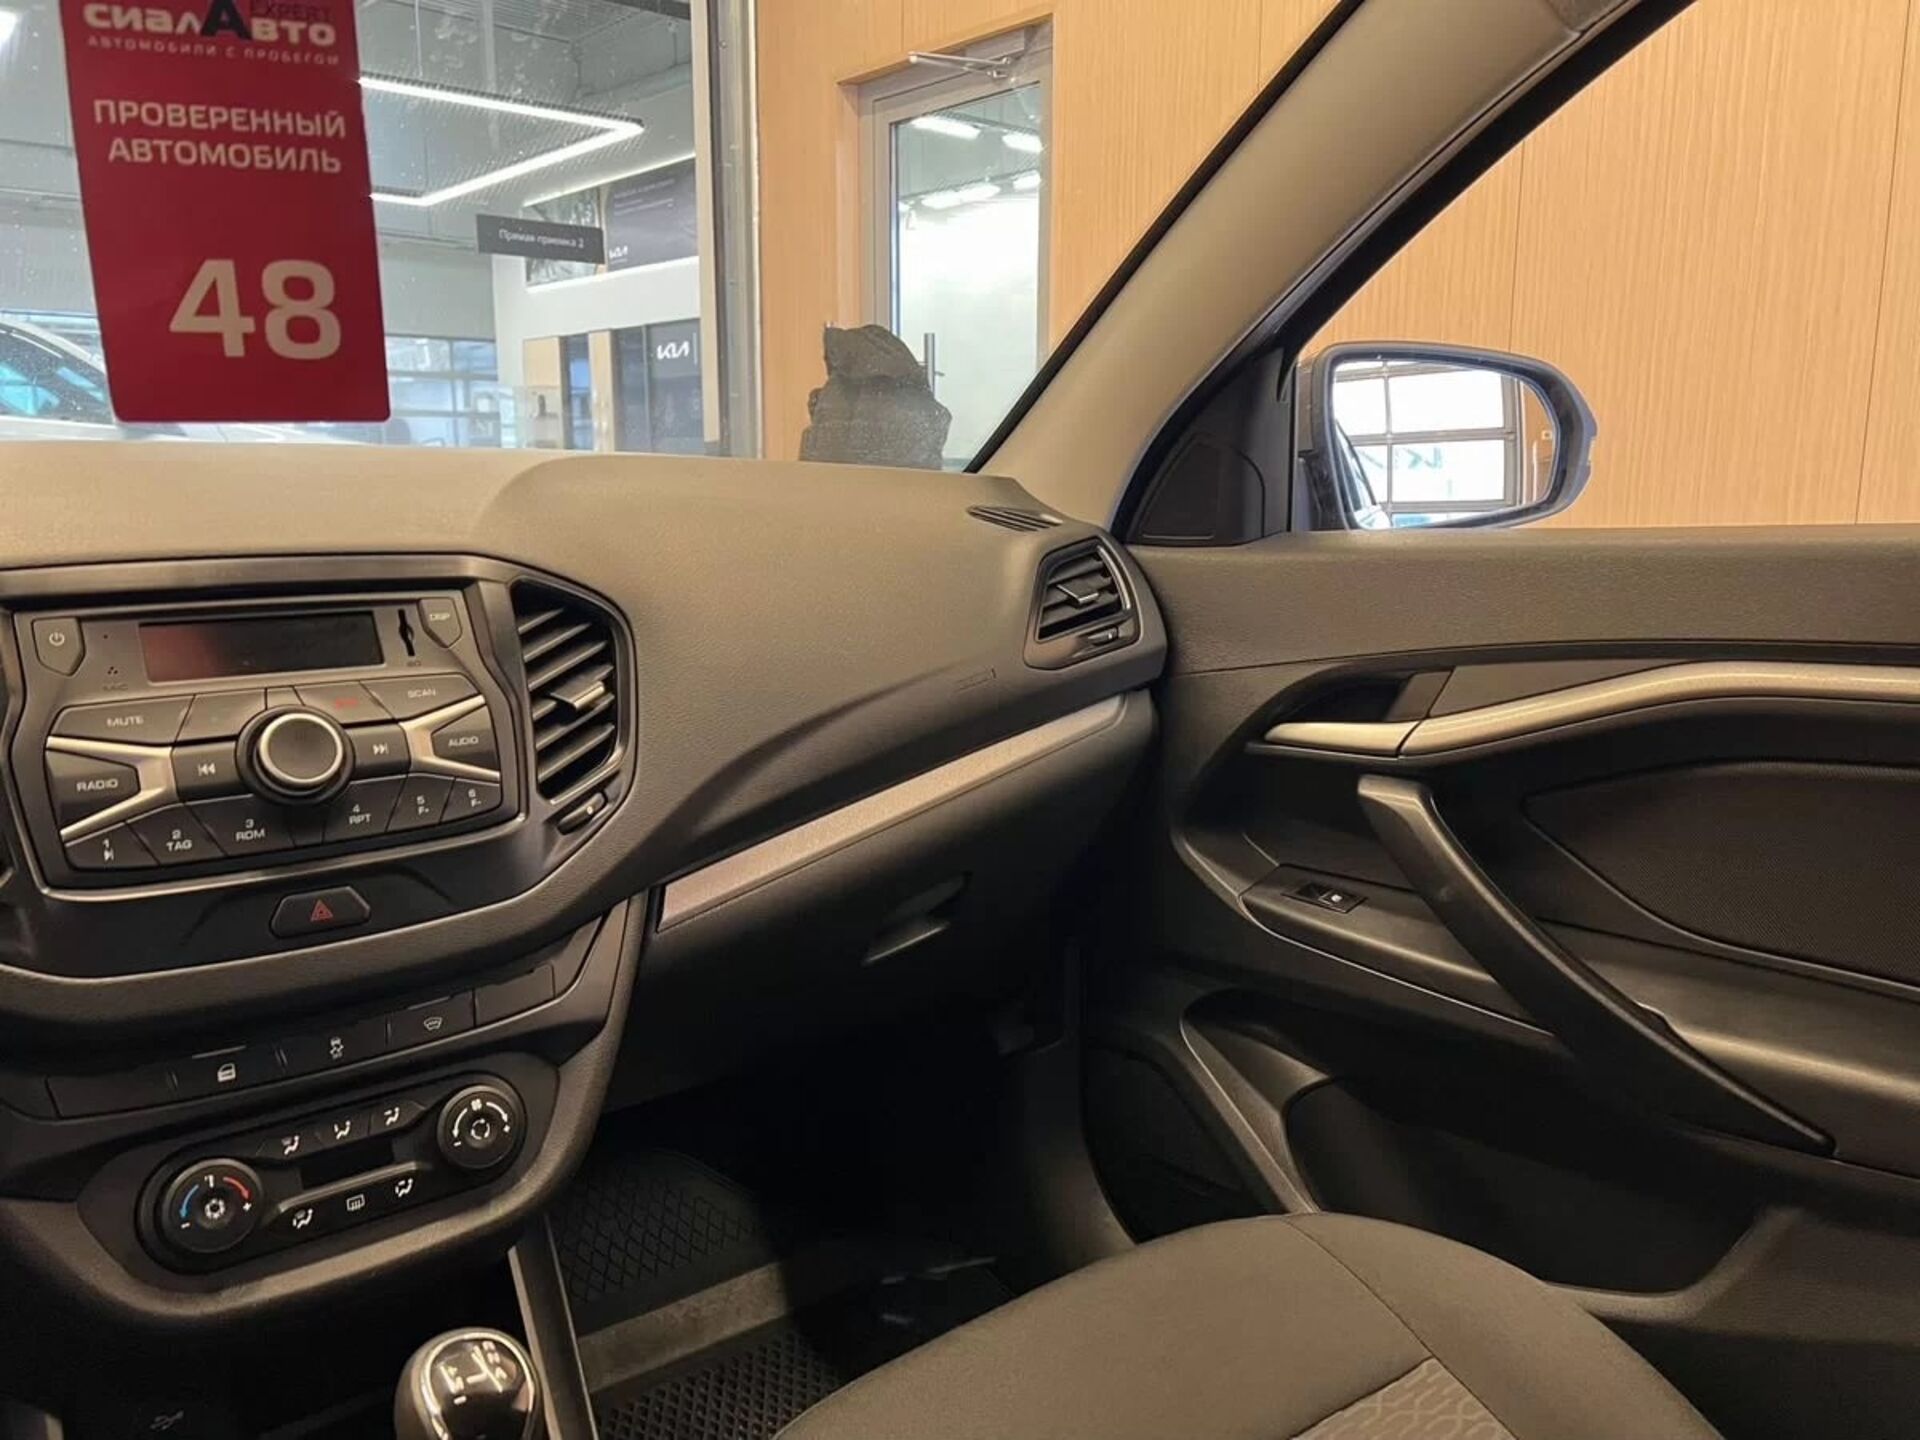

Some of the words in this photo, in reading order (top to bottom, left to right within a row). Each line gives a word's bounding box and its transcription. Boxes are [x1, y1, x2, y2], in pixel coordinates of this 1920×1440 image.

[88, 36, 217, 57] АВТОМОБИЛИ
[244, 48, 340, 66] ПРОБЕГОМ
[94, 99, 346, 138] ПРОВЕРЕННЫЙ
[109, 138, 342, 173] АВТОМОБИЛЬ
[169, 259, 342, 360] 48
[656, 341, 690, 360] KIA
[407, 687, 437, 698] SCAN
[106, 714, 145, 728] MUTE
[448, 735, 480, 747] AUDIO
[76, 778, 119, 793] RADIO
[352, 803, 361, 813] 4
[245, 818, 255, 830] 3
[349, 812, 372, 825] RPT
[171, 829, 182, 840] 2
[102, 838, 110, 849] 1
[165, 839, 193, 853] TAG
